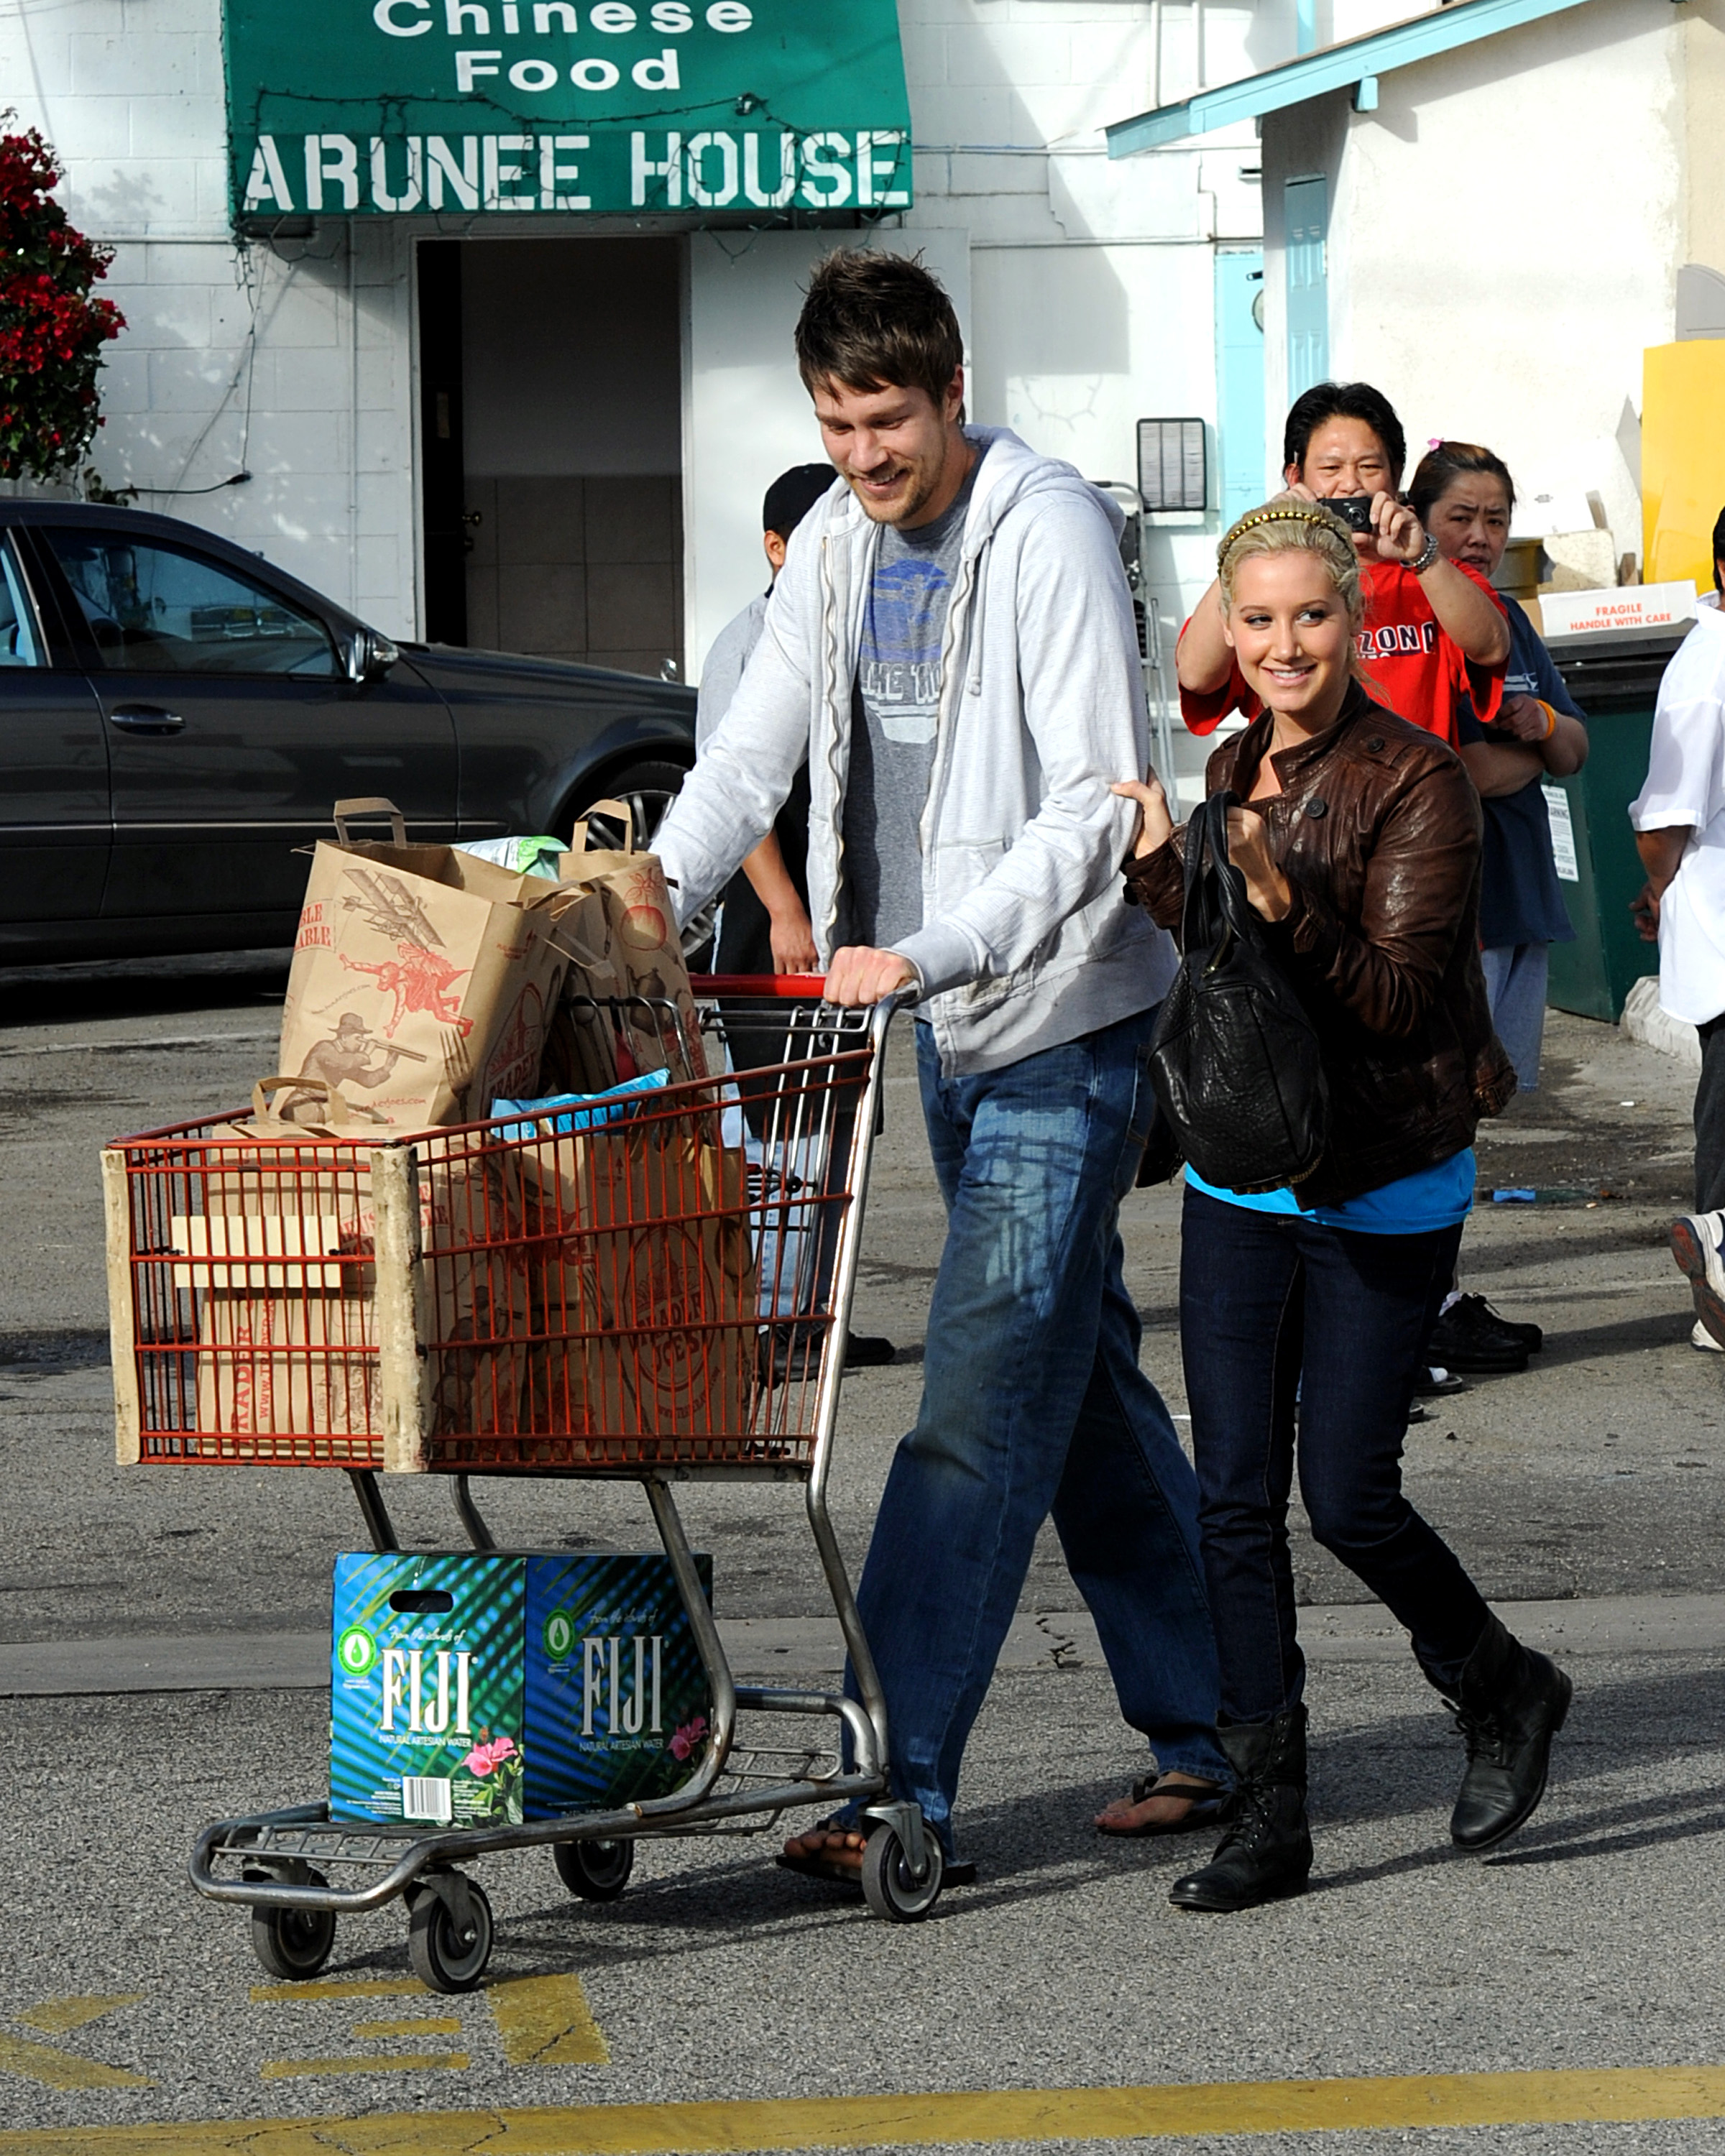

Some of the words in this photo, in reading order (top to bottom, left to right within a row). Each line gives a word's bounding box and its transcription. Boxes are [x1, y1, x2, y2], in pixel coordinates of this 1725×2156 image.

[372, 0, 754, 37] Chinese
[455, 49, 681, 93] Food
[242, 132, 592, 211] ARUNEE
[630, 130, 909, 208] HOUSE
[1570, 618, 1611, 631] HANDLE
[1614, 616, 1642, 627] WITH
[1645, 612, 1672, 624] CARE
[1596, 602, 1642, 616] FRAGILE
[293, 925, 332, 952] ABLE
[380, 1648, 472, 1735] FIJI
[580, 1635, 664, 1736] FIJI
[379, 1735, 410, 1746] NATURAL
[411, 1736, 446, 1747] ARTESIAN
[446, 1737, 472, 1748] WATER
[579, 1741, 610, 1753] NATURAL
